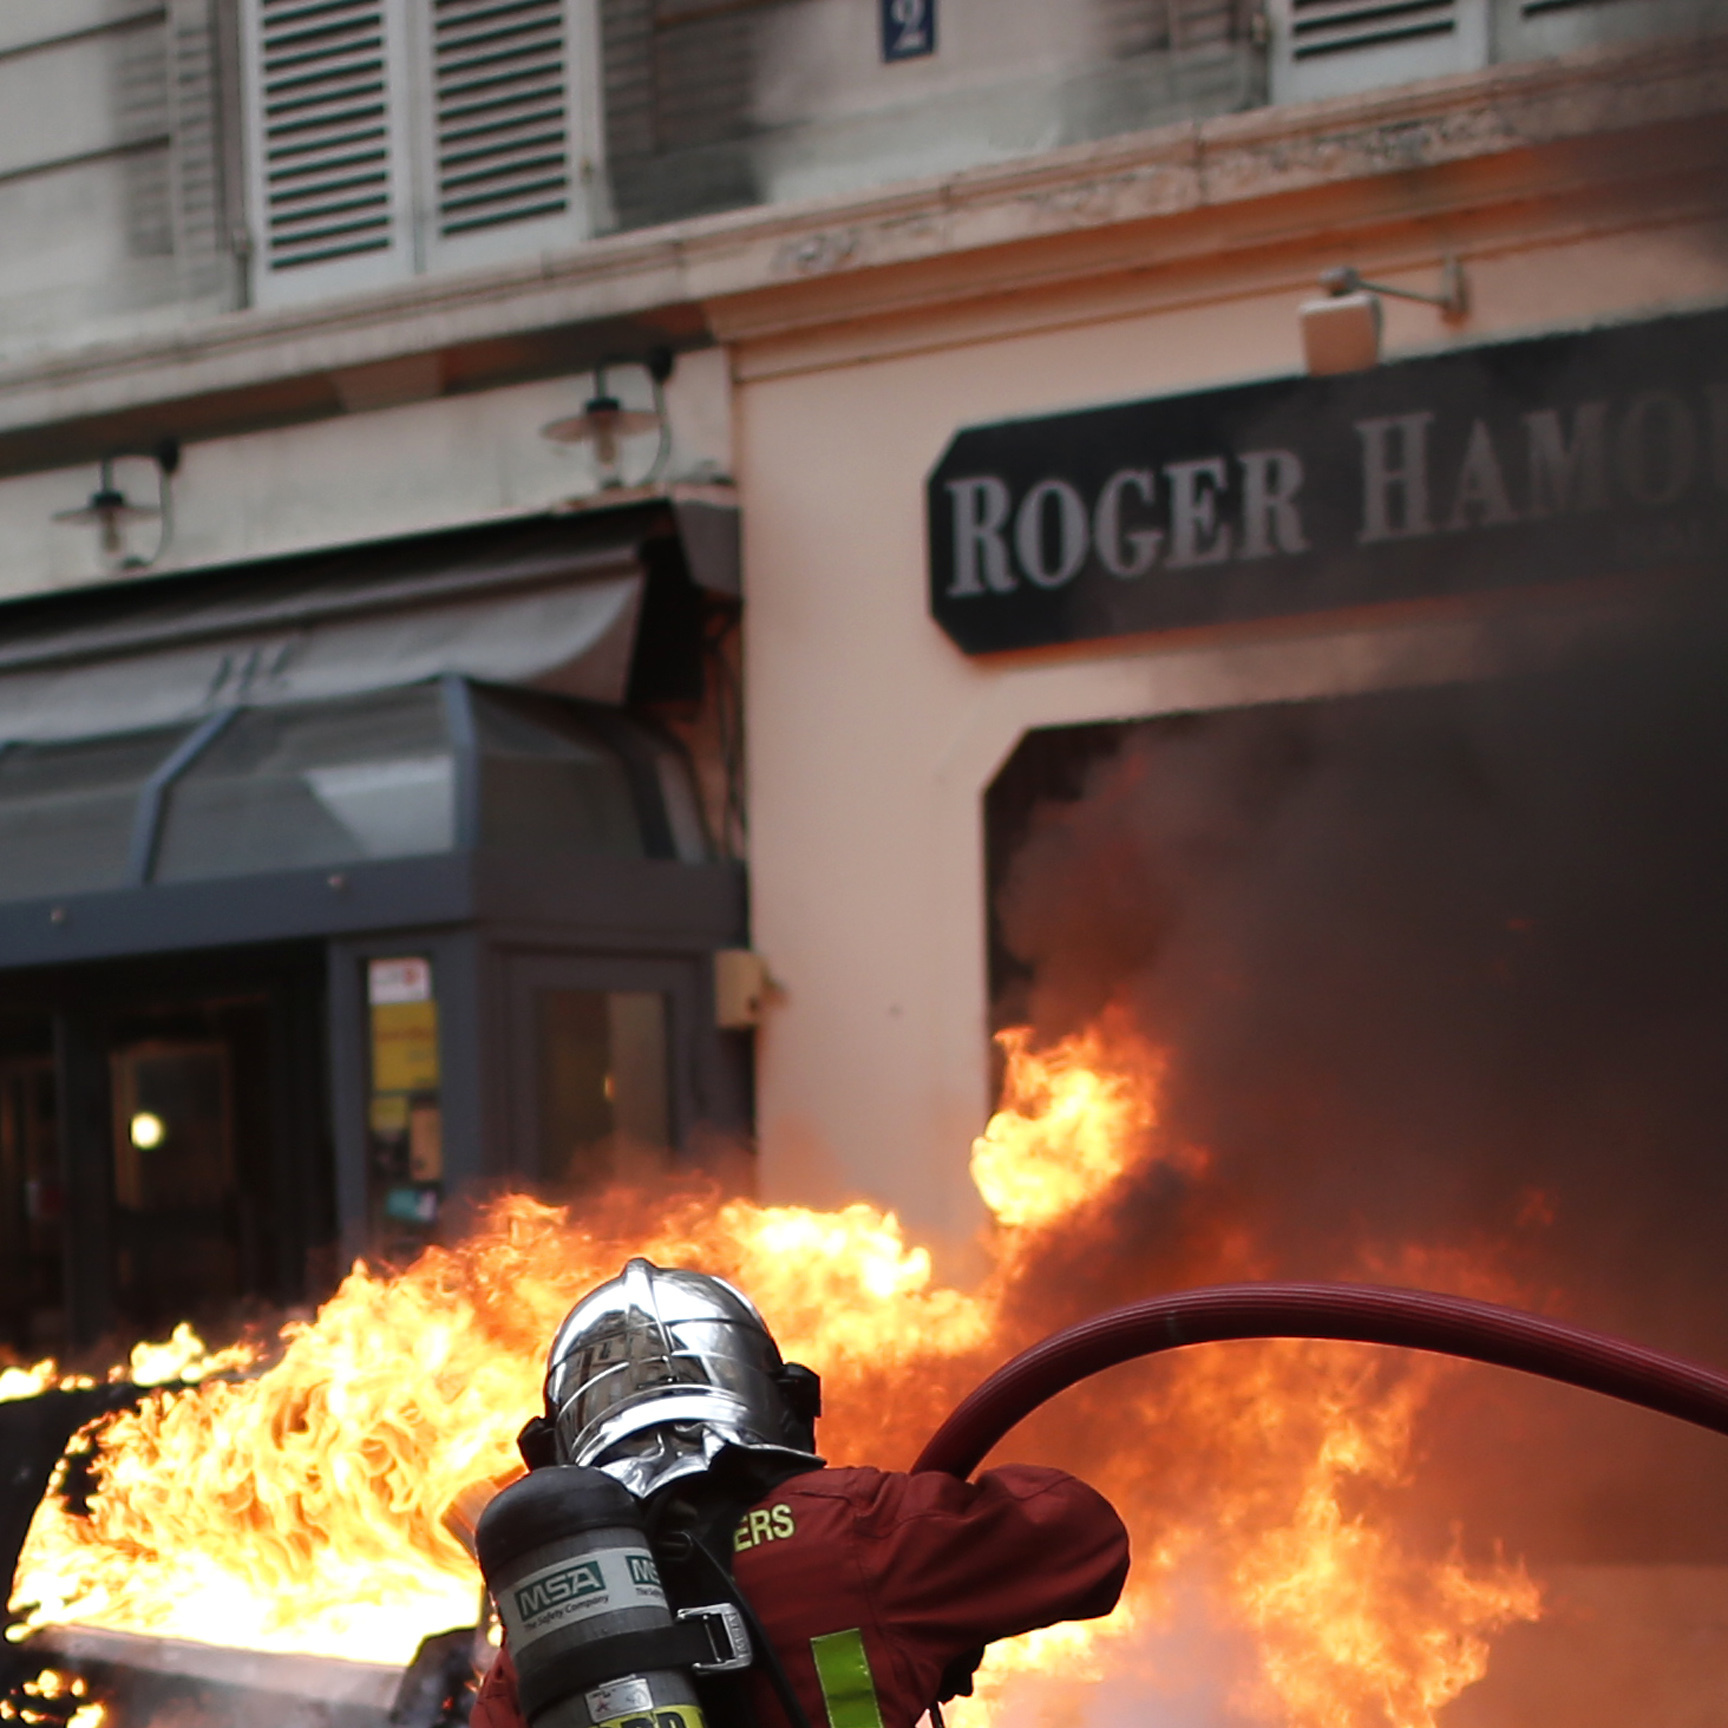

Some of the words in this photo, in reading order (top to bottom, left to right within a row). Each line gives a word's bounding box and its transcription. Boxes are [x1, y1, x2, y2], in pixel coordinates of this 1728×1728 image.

[943, 447, 1310, 600] ROGER
[519, 1565, 603, 1617] MSA
[536, 1608, 564, 1627] Safety
[563, 1594, 610, 1616] Company
